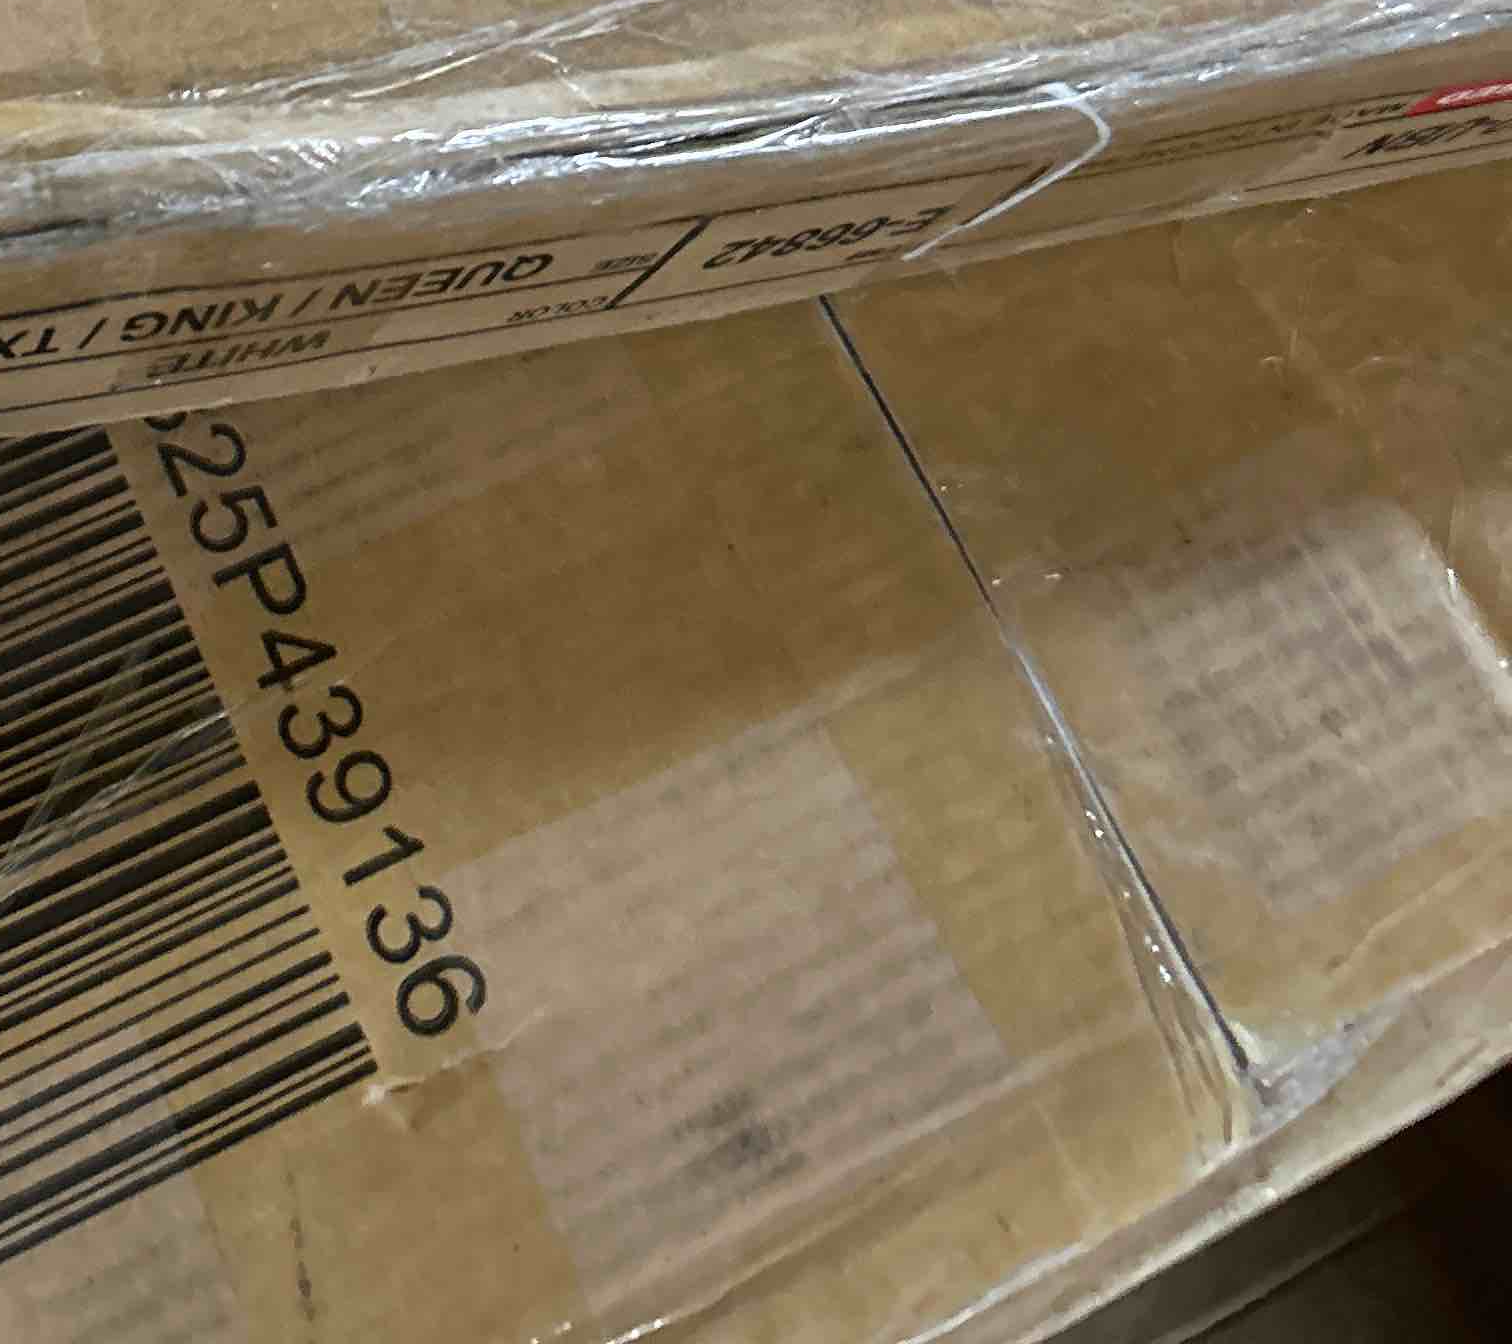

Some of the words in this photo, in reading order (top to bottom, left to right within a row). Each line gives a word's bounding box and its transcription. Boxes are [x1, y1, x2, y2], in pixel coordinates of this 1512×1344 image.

[329, 253, 553, 310] QUEEN
[120, 293, 285, 342] KING
[147, 330, 331, 379] WHITE
[144, 410, 486, 1037] 25P439136
